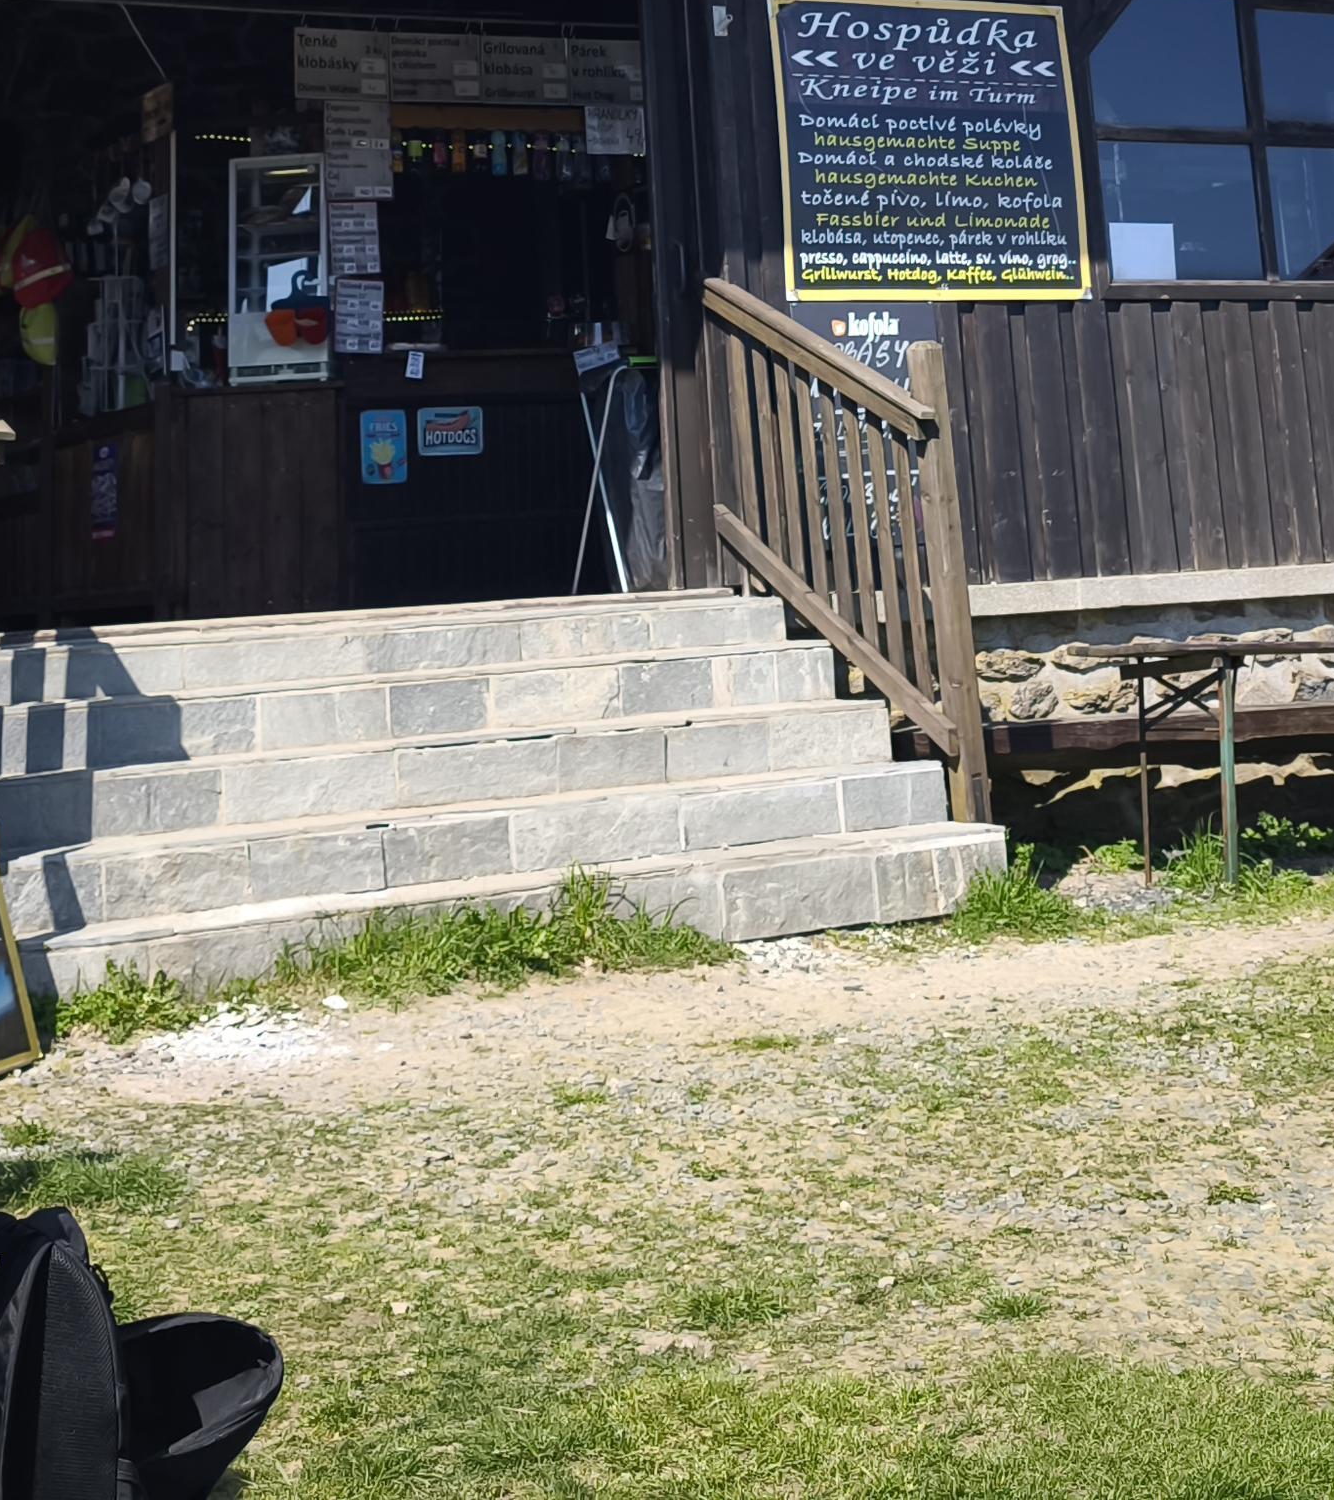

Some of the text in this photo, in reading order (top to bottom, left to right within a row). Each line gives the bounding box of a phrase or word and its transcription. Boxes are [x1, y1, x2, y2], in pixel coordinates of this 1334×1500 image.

[297, 33, 338, 48] Tenké
[797, 11, 1039, 54] Hospůdka
[483, 41, 546, 56] Grilovaná
[570, 44, 608, 58] Párek
[297, 55, 359, 73] klobásky
[483, 63, 534, 77] klobása
[571, 67, 579, 77] v
[851, 50, 997, 75] ve věži
[800, 78, 1037, 105] Kneipe im Turm
[798, 113, 880, 129] Domácí
[962, 118, 1042, 141] polévky
[814, 132, 1022, 156] hausgemachte Suppe
[797, 151, 1054, 170] Domácí a chodské koláče
[814, 168, 1039, 189] hausgemachte Kuchen
[800, 189, 871, 206] točené
[997, 193, 1064, 213] kofola
[816, 212, 1051, 229] Fassbier und Limonade
[801, 228, 1068, 250] klobása, utopenec, párek v rohlíku
[799, 251, 849, 268] presso,
[851, 249, 933, 270] cappuccino,
[935, 251, 973, 267] latte,
[975, 253, 997, 265] sv.
[999, 249, 1034, 267] víno,
[801, 266, 883, 282] Grillwurst,
[886, 267, 943, 285] Hotdog,
[946, 267, 997, 282] Kaffee,
[848, 311, 900, 343] kofola
[425, 428, 477, 446] HOTDOGS
